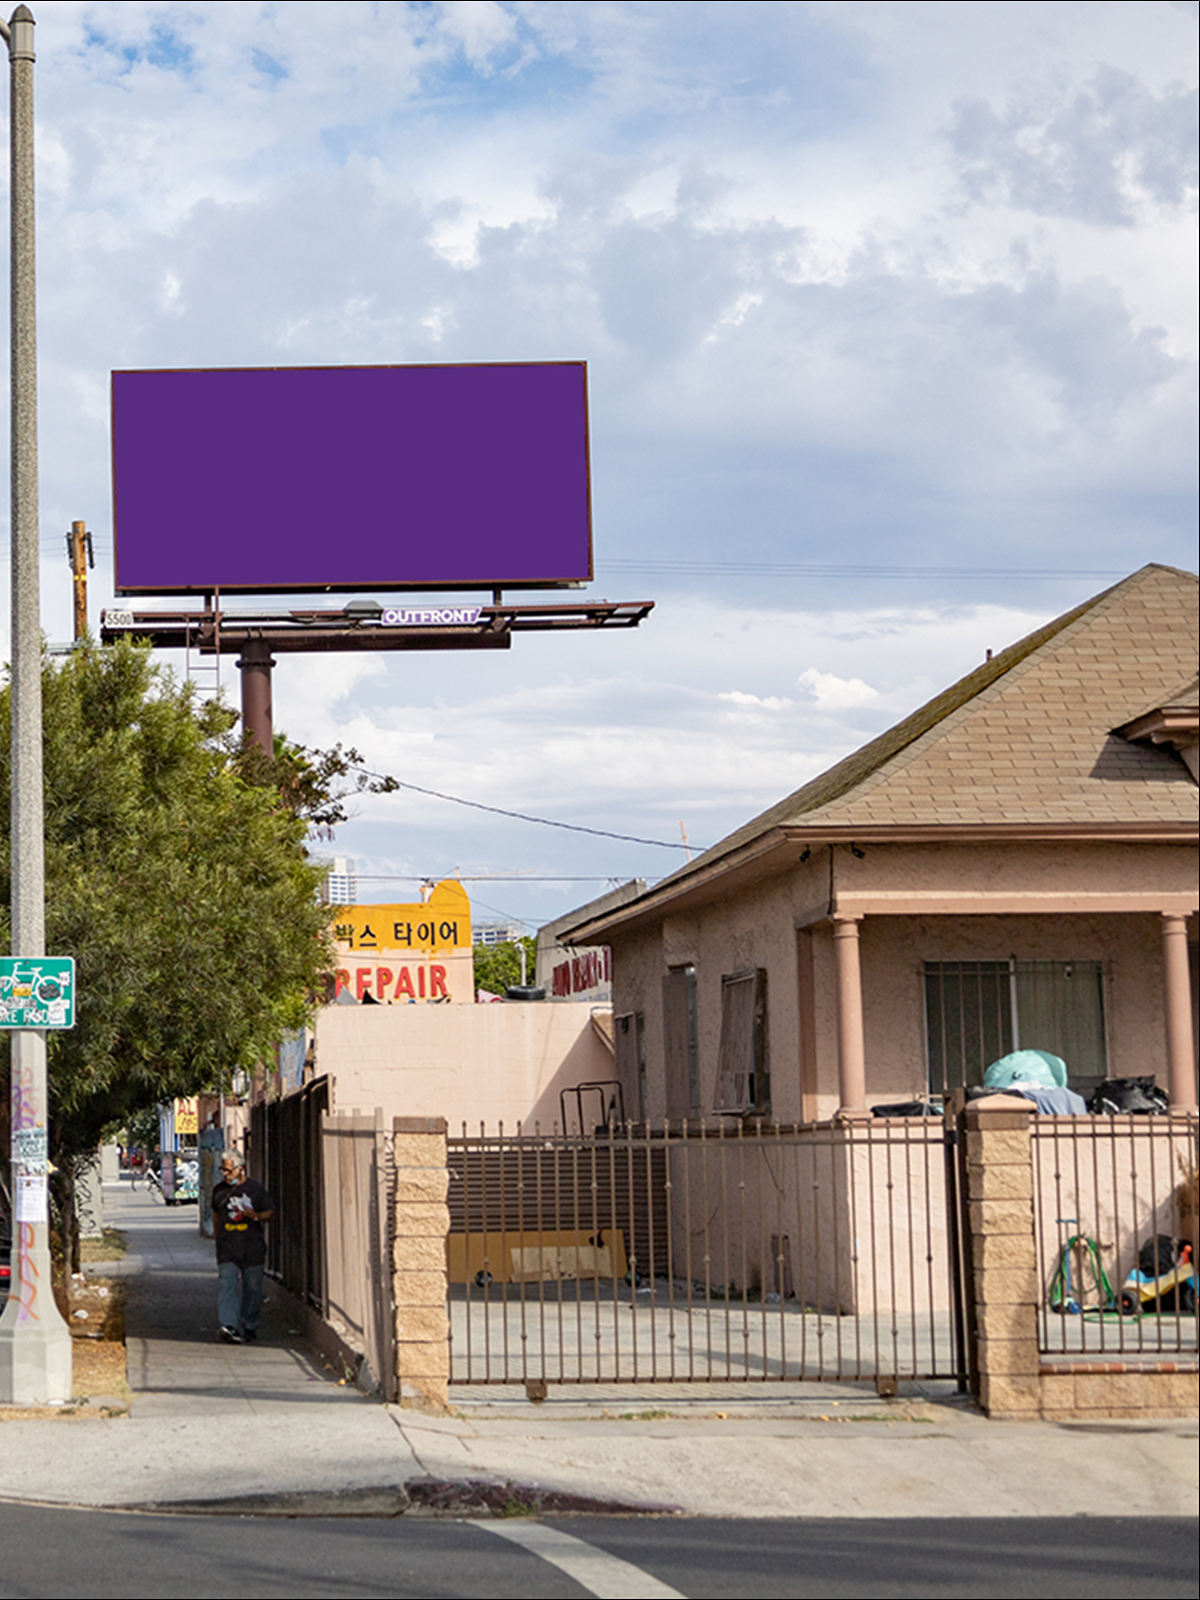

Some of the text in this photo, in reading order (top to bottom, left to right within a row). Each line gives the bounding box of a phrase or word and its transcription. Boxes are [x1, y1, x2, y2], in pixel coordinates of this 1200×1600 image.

[107, 612, 131, 625] 5500
[385, 609, 477, 624] OUTFRONT
[393, 921, 458, 946] 타이어
[335, 964, 449, 1000] REPAIR
